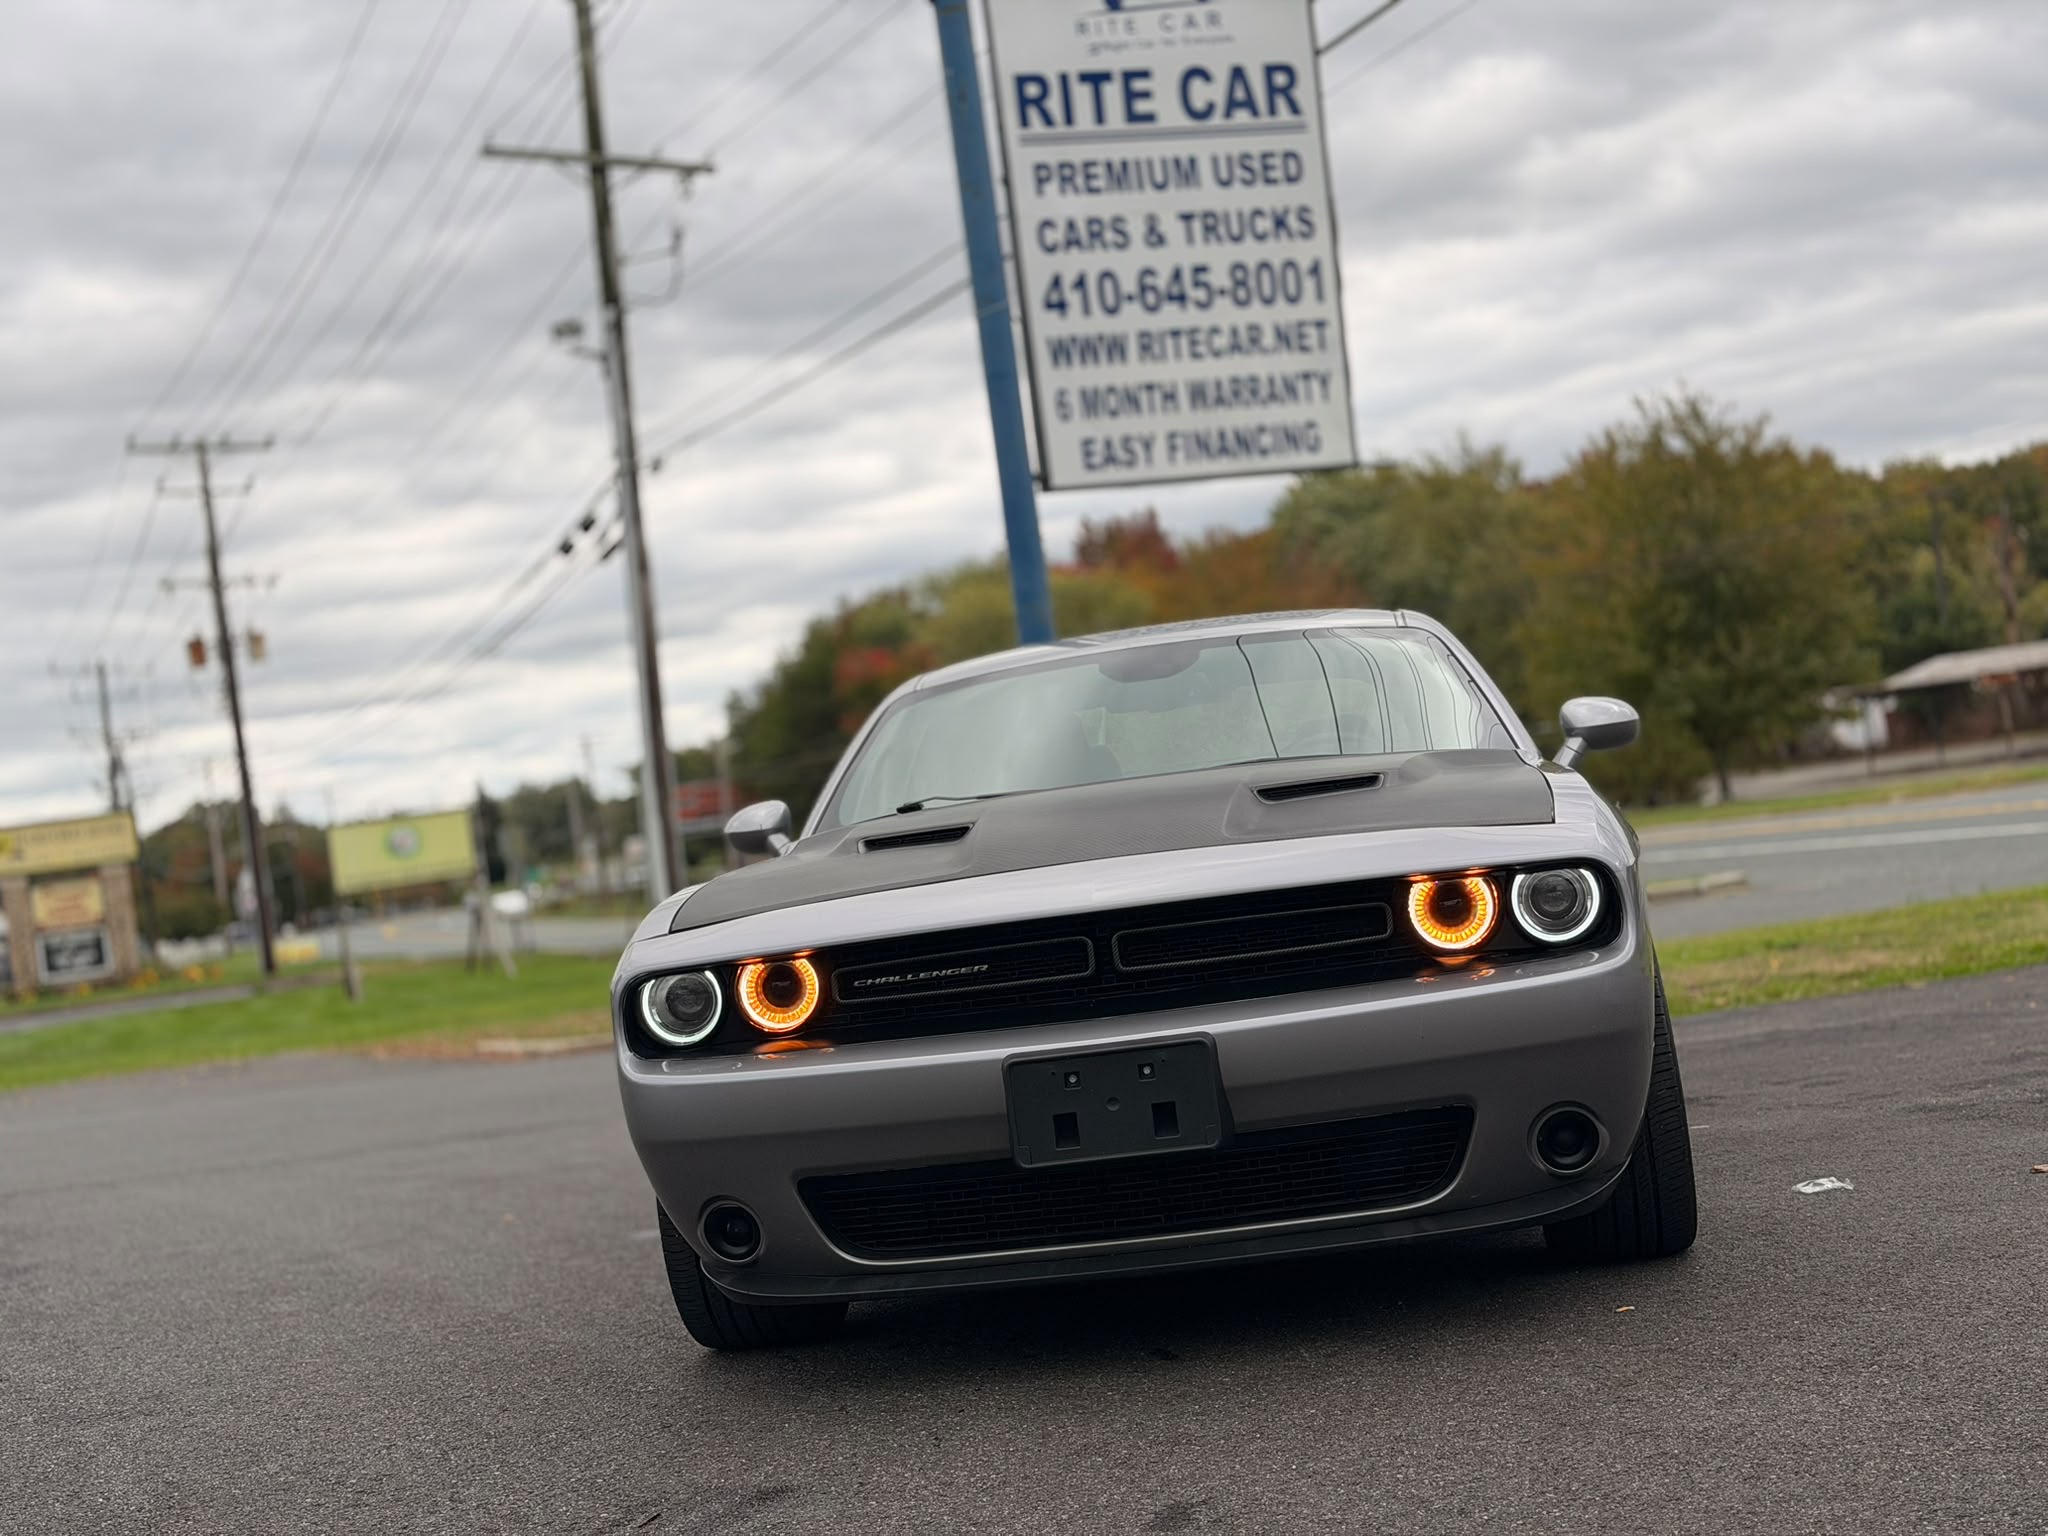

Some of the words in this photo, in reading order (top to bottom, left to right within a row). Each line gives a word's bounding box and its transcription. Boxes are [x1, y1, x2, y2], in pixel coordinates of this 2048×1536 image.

[1158, 10, 1223, 33] CAR
[1014, 70, 1157, 128] RITE
[1179, 63, 1302, 121] CAR
[1033, 157, 1200, 196] PREMIUM
[1213, 152, 1303, 188] USED
[1036, 216, 1130, 253] CARS
[1144, 214, 1167, 248] &
[1179, 207, 1314, 248] TRUCKS
[1043, 260, 1326, 317] 410-645-8001
[1055, 387, 1074, 422] 6
[1079, 381, 1180, 420] MONTH
[1187, 371, 1332, 411] WARRANTY
[1081, 434, 1156, 472] EASY
[1167, 422, 1321, 465] FINANCING
[853, 964, 989, 987] CHALLENGER
